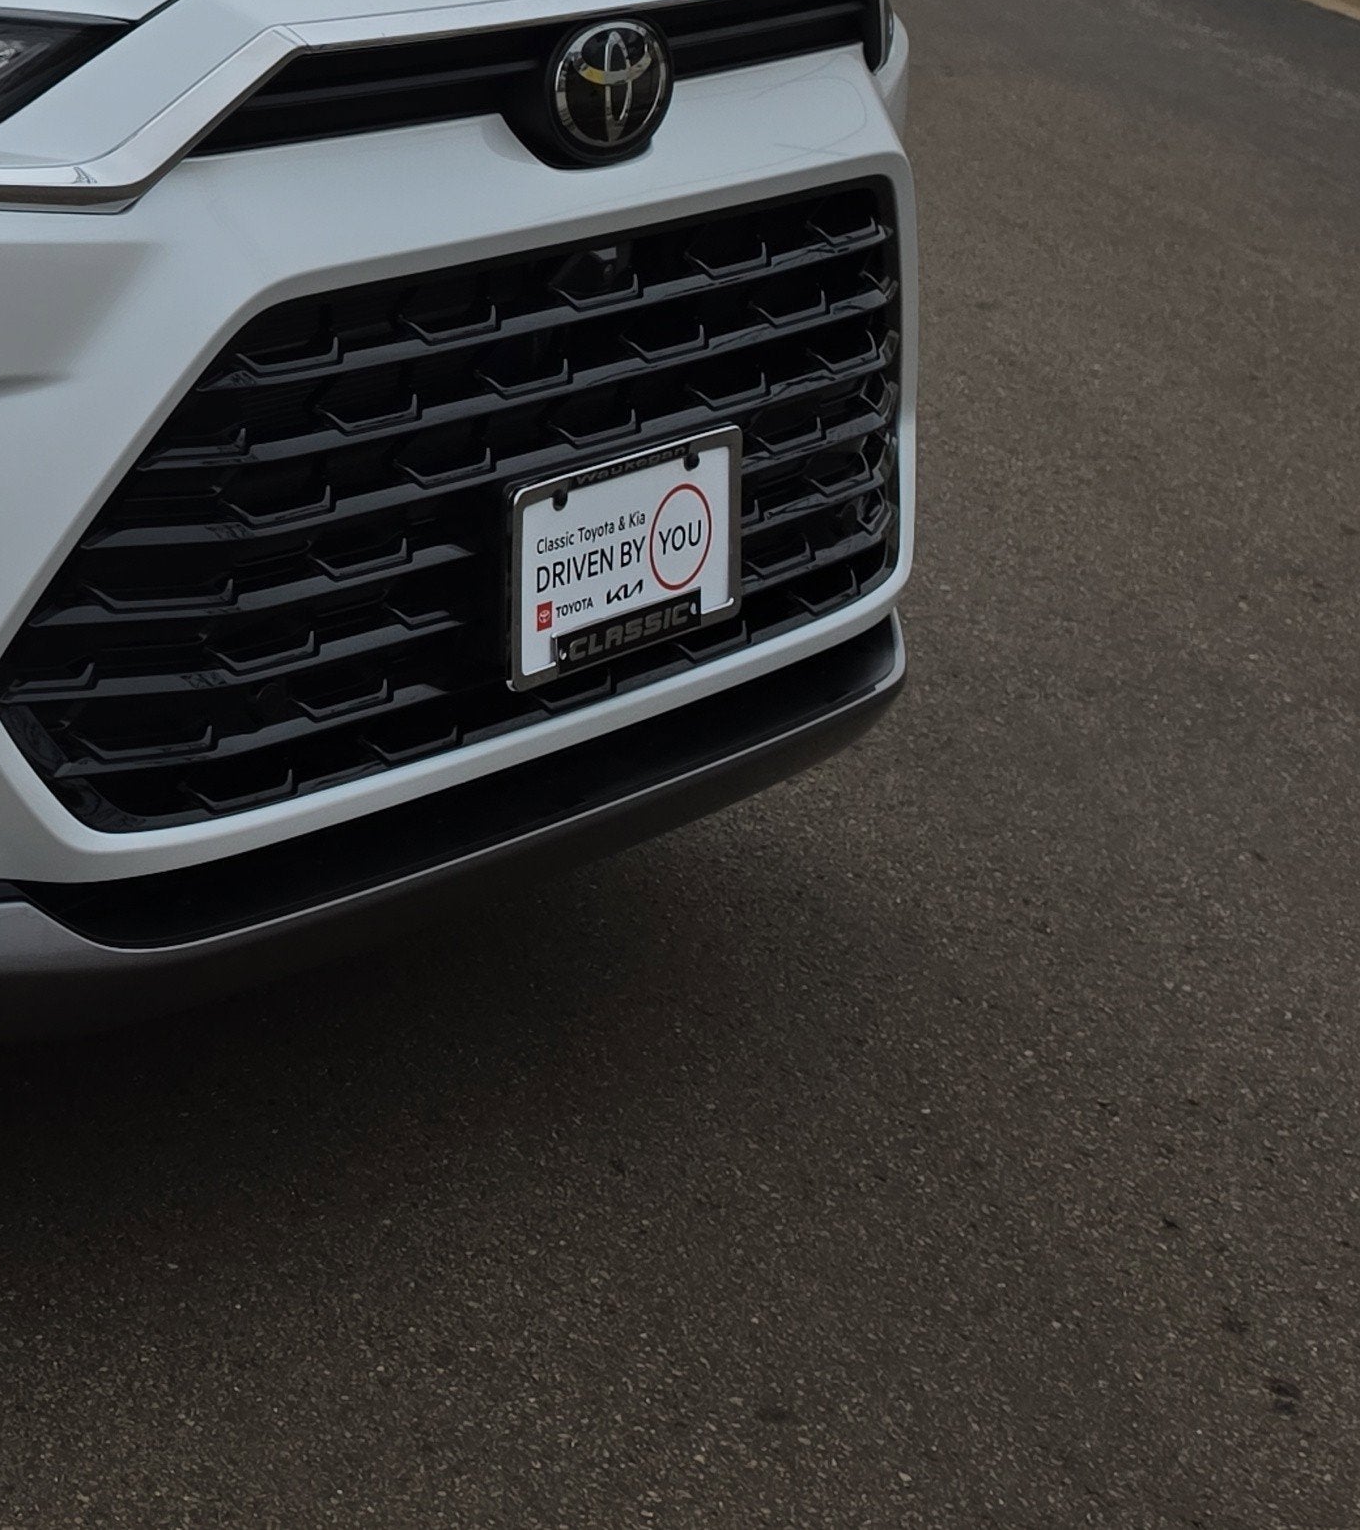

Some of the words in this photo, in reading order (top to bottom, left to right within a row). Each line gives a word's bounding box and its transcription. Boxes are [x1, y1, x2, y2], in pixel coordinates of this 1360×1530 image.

[536, 531, 575, 555] Classic
[578, 521, 615, 543] Toyota
[618, 516, 626, 531] &
[629, 511, 646, 528] Kia
[537, 545, 614, 594] DRIVEN
[620, 535, 646, 568] BY
[659, 520, 702, 555] YOU
[556, 597, 594, 619] TOYOTA
[569, 602, 690, 662] CLASSIC
